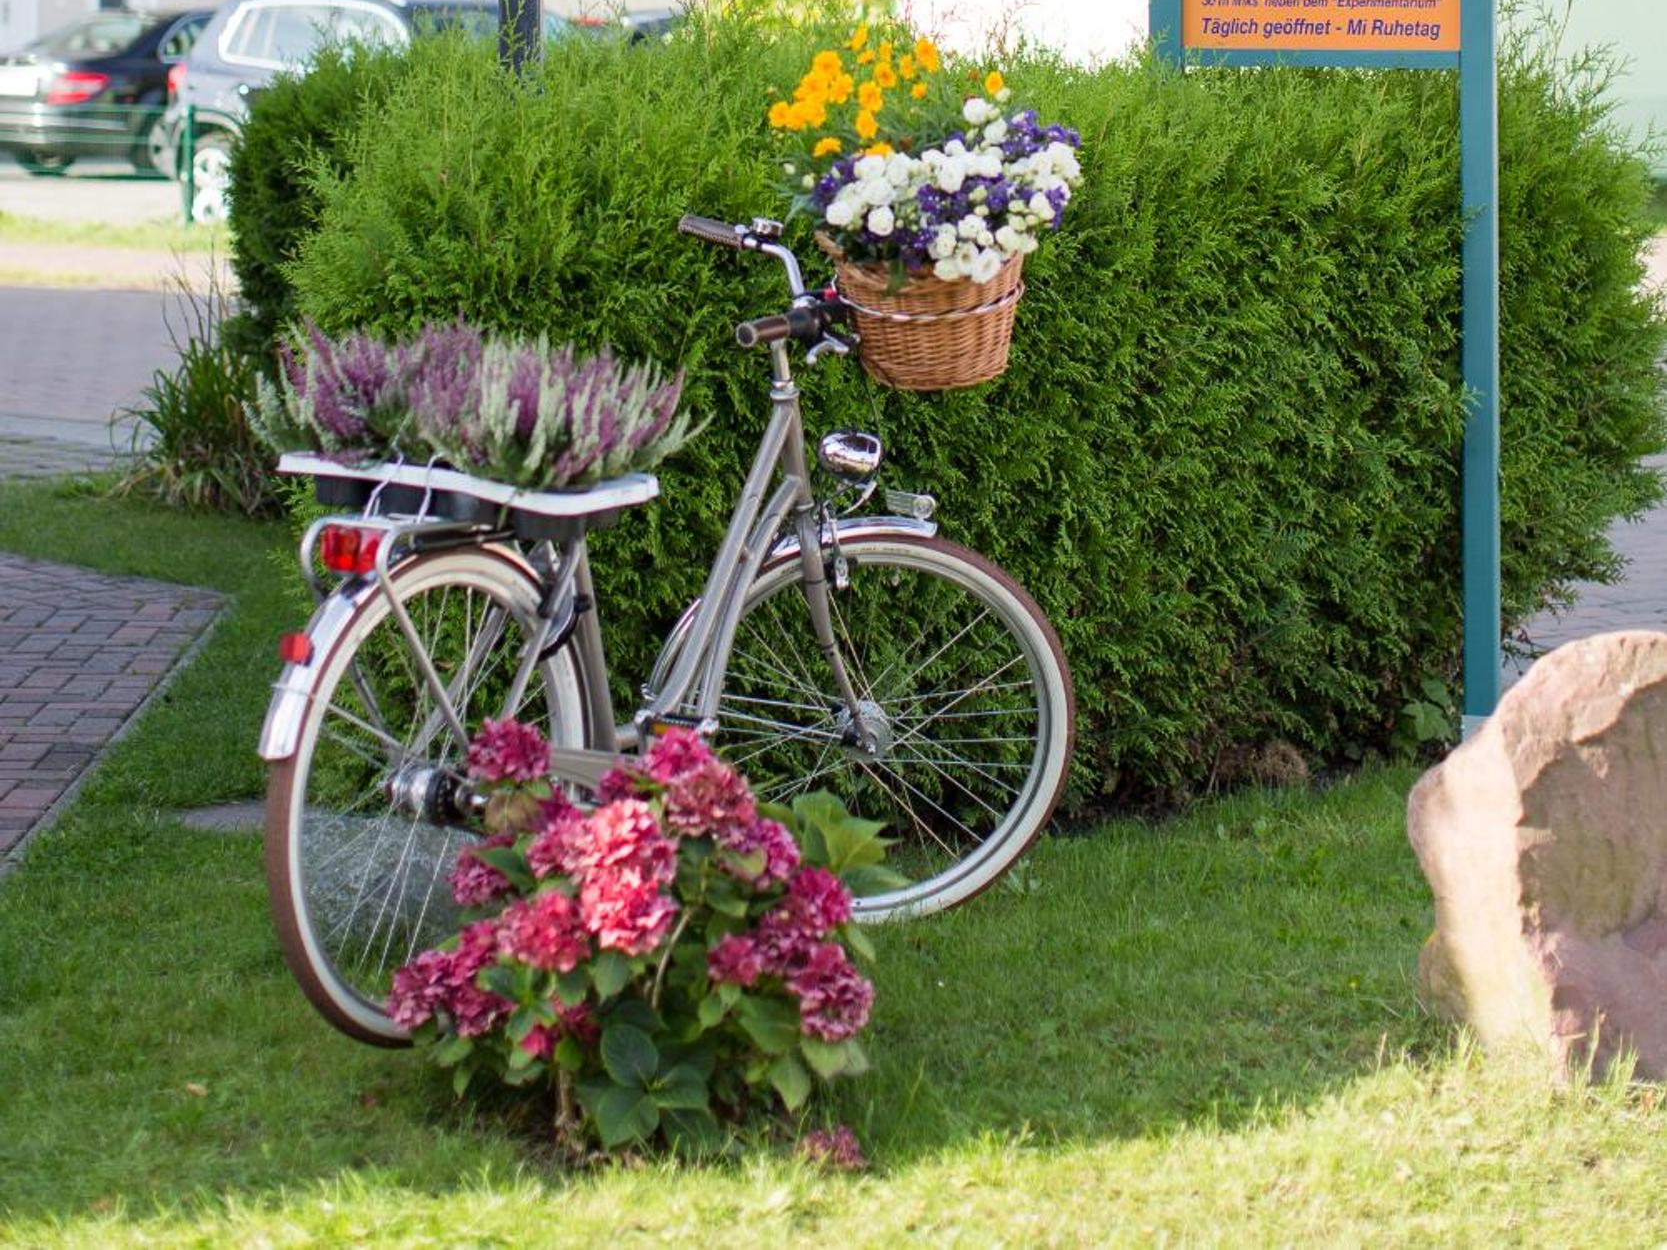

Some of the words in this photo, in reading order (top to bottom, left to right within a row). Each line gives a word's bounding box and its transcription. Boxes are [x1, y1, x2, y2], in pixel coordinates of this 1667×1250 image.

[1202, 18, 1258, 38] Täglich
[1263, 18, 1331, 39] geöffnet
[1347, 19, 1367, 35] Mi
[1371, 20, 1441, 41] Ruhetag
